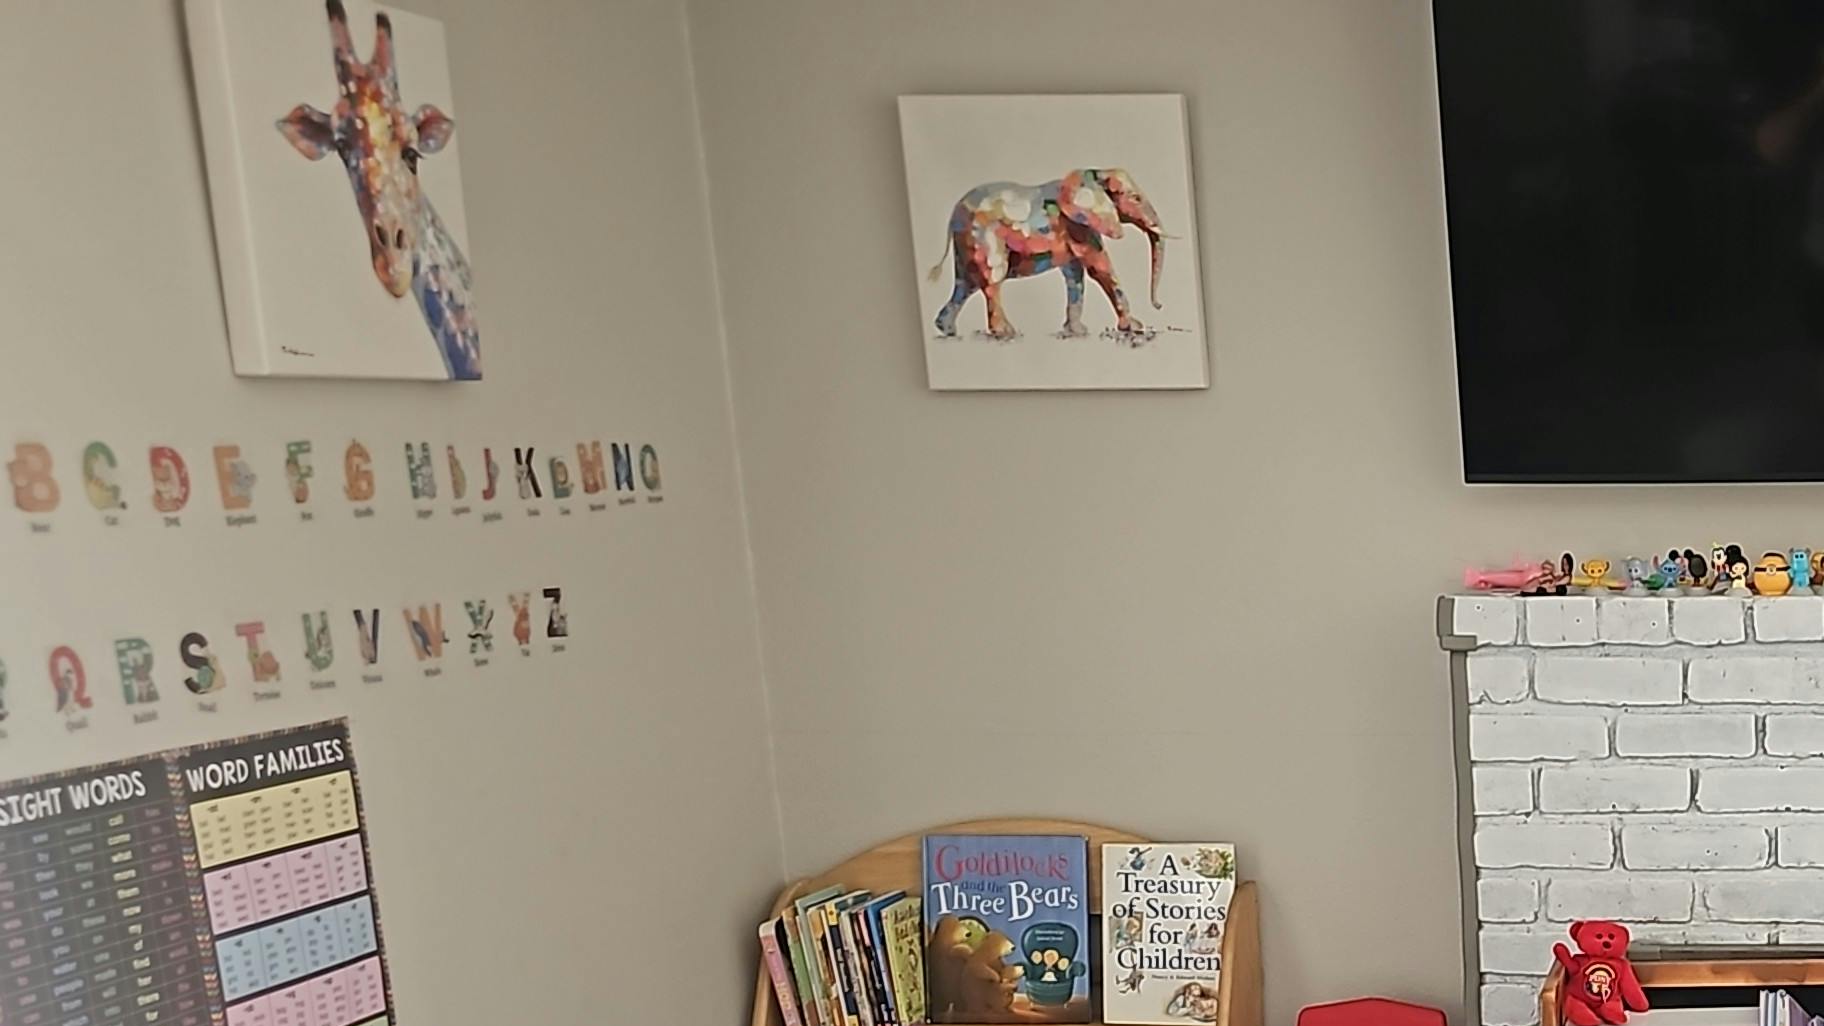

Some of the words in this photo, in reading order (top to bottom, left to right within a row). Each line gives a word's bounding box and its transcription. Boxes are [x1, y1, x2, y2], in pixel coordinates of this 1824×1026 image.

[11, 442, 60, 512] B
[82, 441, 120, 510] C
[149, 446, 190, 512] D
[213, 445, 252, 510] E
[344, 441, 375, 502] G
[404, 442, 436, 499] H
[482, 447, 497, 500] J
[514, 447, 542, 498] K
[611, 443, 634, 491] N
[49, 646, 93, 708] Q
[115, 638, 160, 704] R
[180, 632, 214, 694] S
[235, 622, 276, 682] T
[302, 611, 334, 671] U
[353, 609, 380, 664] V
[403, 603, 443, 661] W
[464, 600, 493, 653] X
[508, 592, 531, 645] Y
[543, 587, 567, 638] Z
[186, 758, 249, 793] WORD
[254, 738, 346, 780] FAMILIES
[0, 787, 62, 827] SIGHT
[68, 770, 147, 815] WORDS
[934, 844, 1070, 882] Goldilocks
[1159, 854, 1180, 876] A
[931, 881, 1006, 916] Three
[1008, 880, 1079, 922] Bears
[960, 879, 986, 892] and
[1116, 871, 1221, 901] Treasury
[1112, 896, 1141, 919] of
[1145, 897, 1226, 921] Stories
[1148, 922, 1183, 945] for
[1117, 947, 1221, 971] Children
